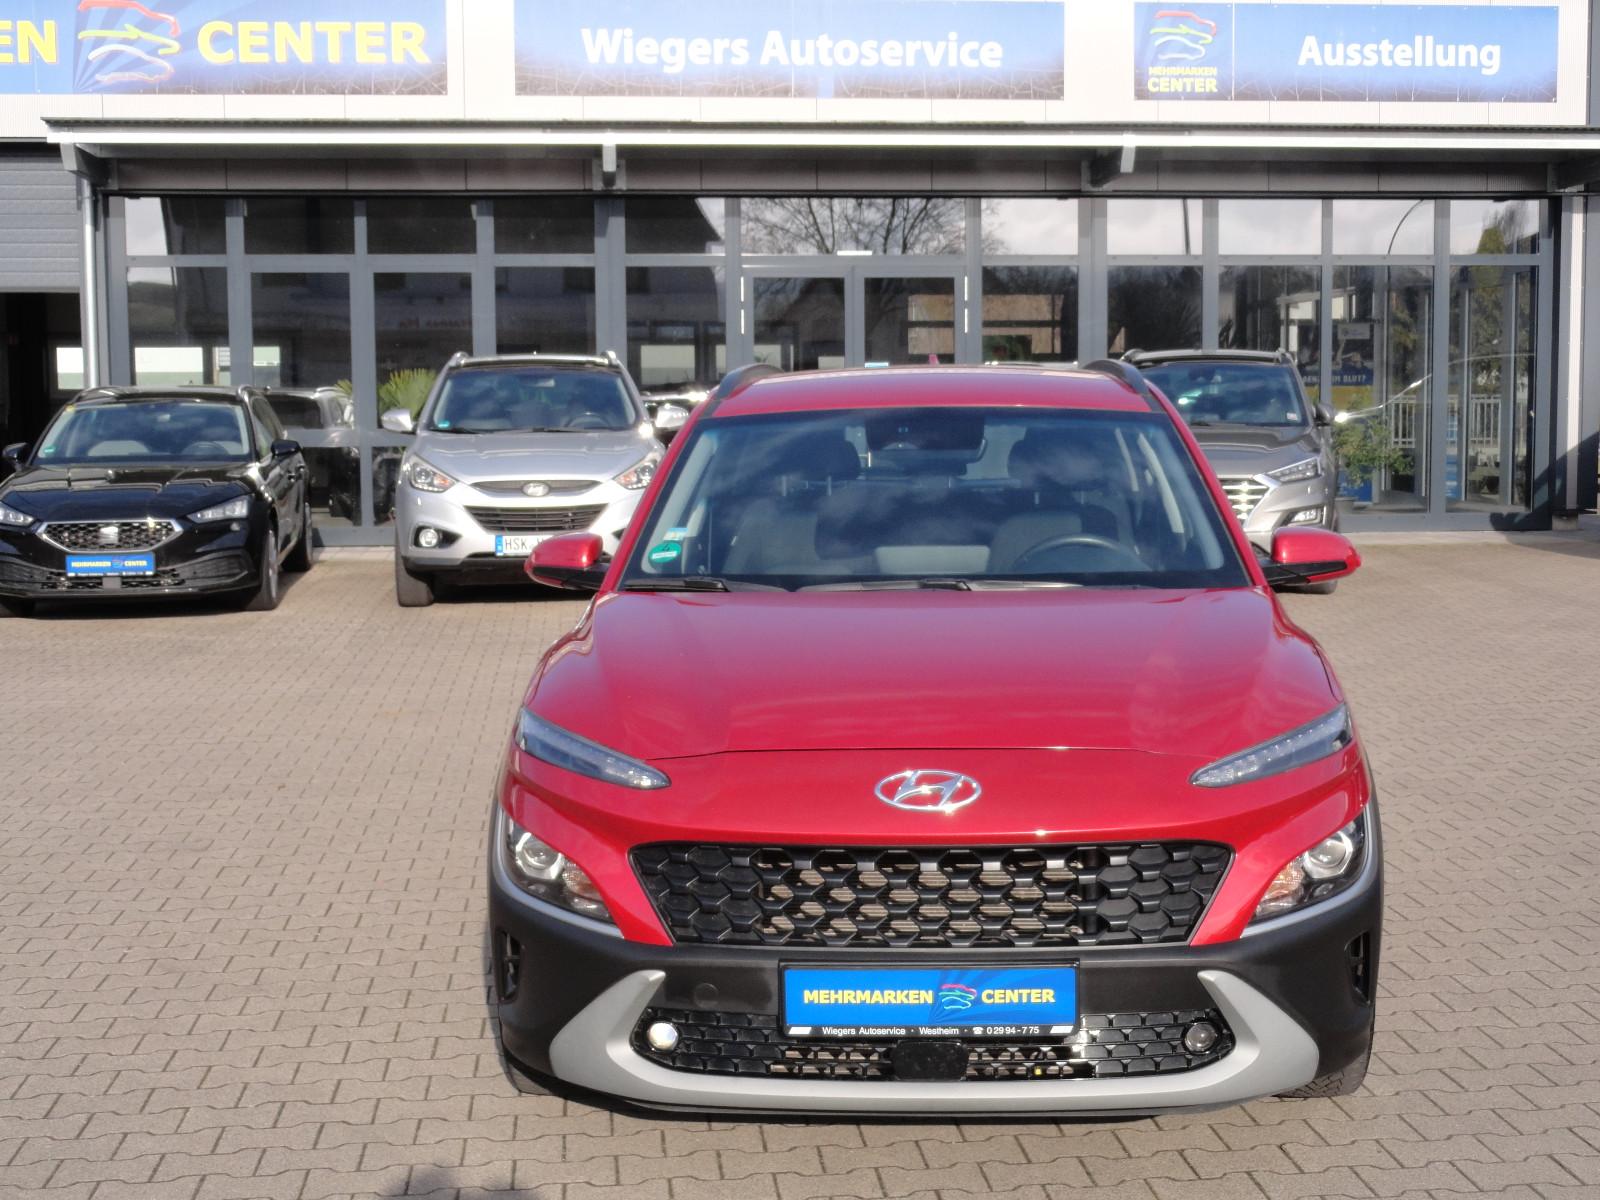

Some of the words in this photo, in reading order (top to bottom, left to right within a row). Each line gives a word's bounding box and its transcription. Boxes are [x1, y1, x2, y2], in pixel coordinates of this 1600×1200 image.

[197, 20, 431, 64] CENTER
[581, 28, 749, 73] Wiegers
[760, 31, 1004, 68] Autoservice
[1298, 35, 1501, 75] Ausstellung
[1148, 66, 1217, 76] MEHRMARKEN
[1148, 77, 1218, 92] CENTER
[505, 538, 527, 550] HSK
[803, 989, 933, 1004] MEHRMARKEN
[981, 989, 1055, 1004] CENTER
[822, 1026, 856, 1036] Wiegers
[858, 1026, 906, 1035] Autoservice
[919, 1026, 960, 1035] Westheim
